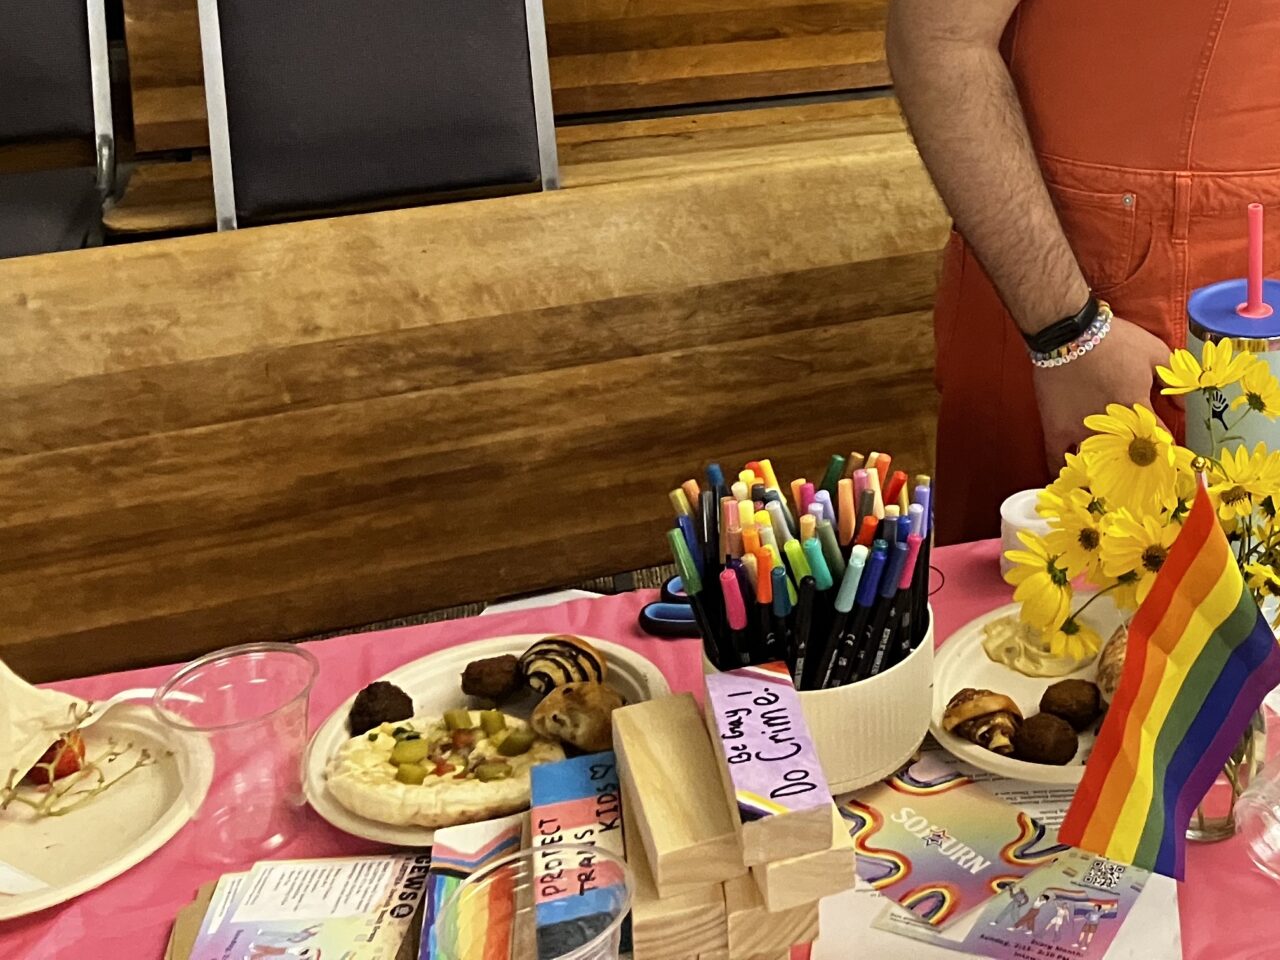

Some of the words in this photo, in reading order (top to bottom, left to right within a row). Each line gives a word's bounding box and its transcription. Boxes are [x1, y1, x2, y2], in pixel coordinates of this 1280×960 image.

[721, 708, 752, 743] Gay
[753, 687, 802, 761] Crime.
[728, 744, 752, 764] Be
[596, 783, 621, 831] KIDS
[770, 769, 817, 799] Do
[539, 817, 567, 897] PROTECT
[573, 829, 596, 897] TRANS
